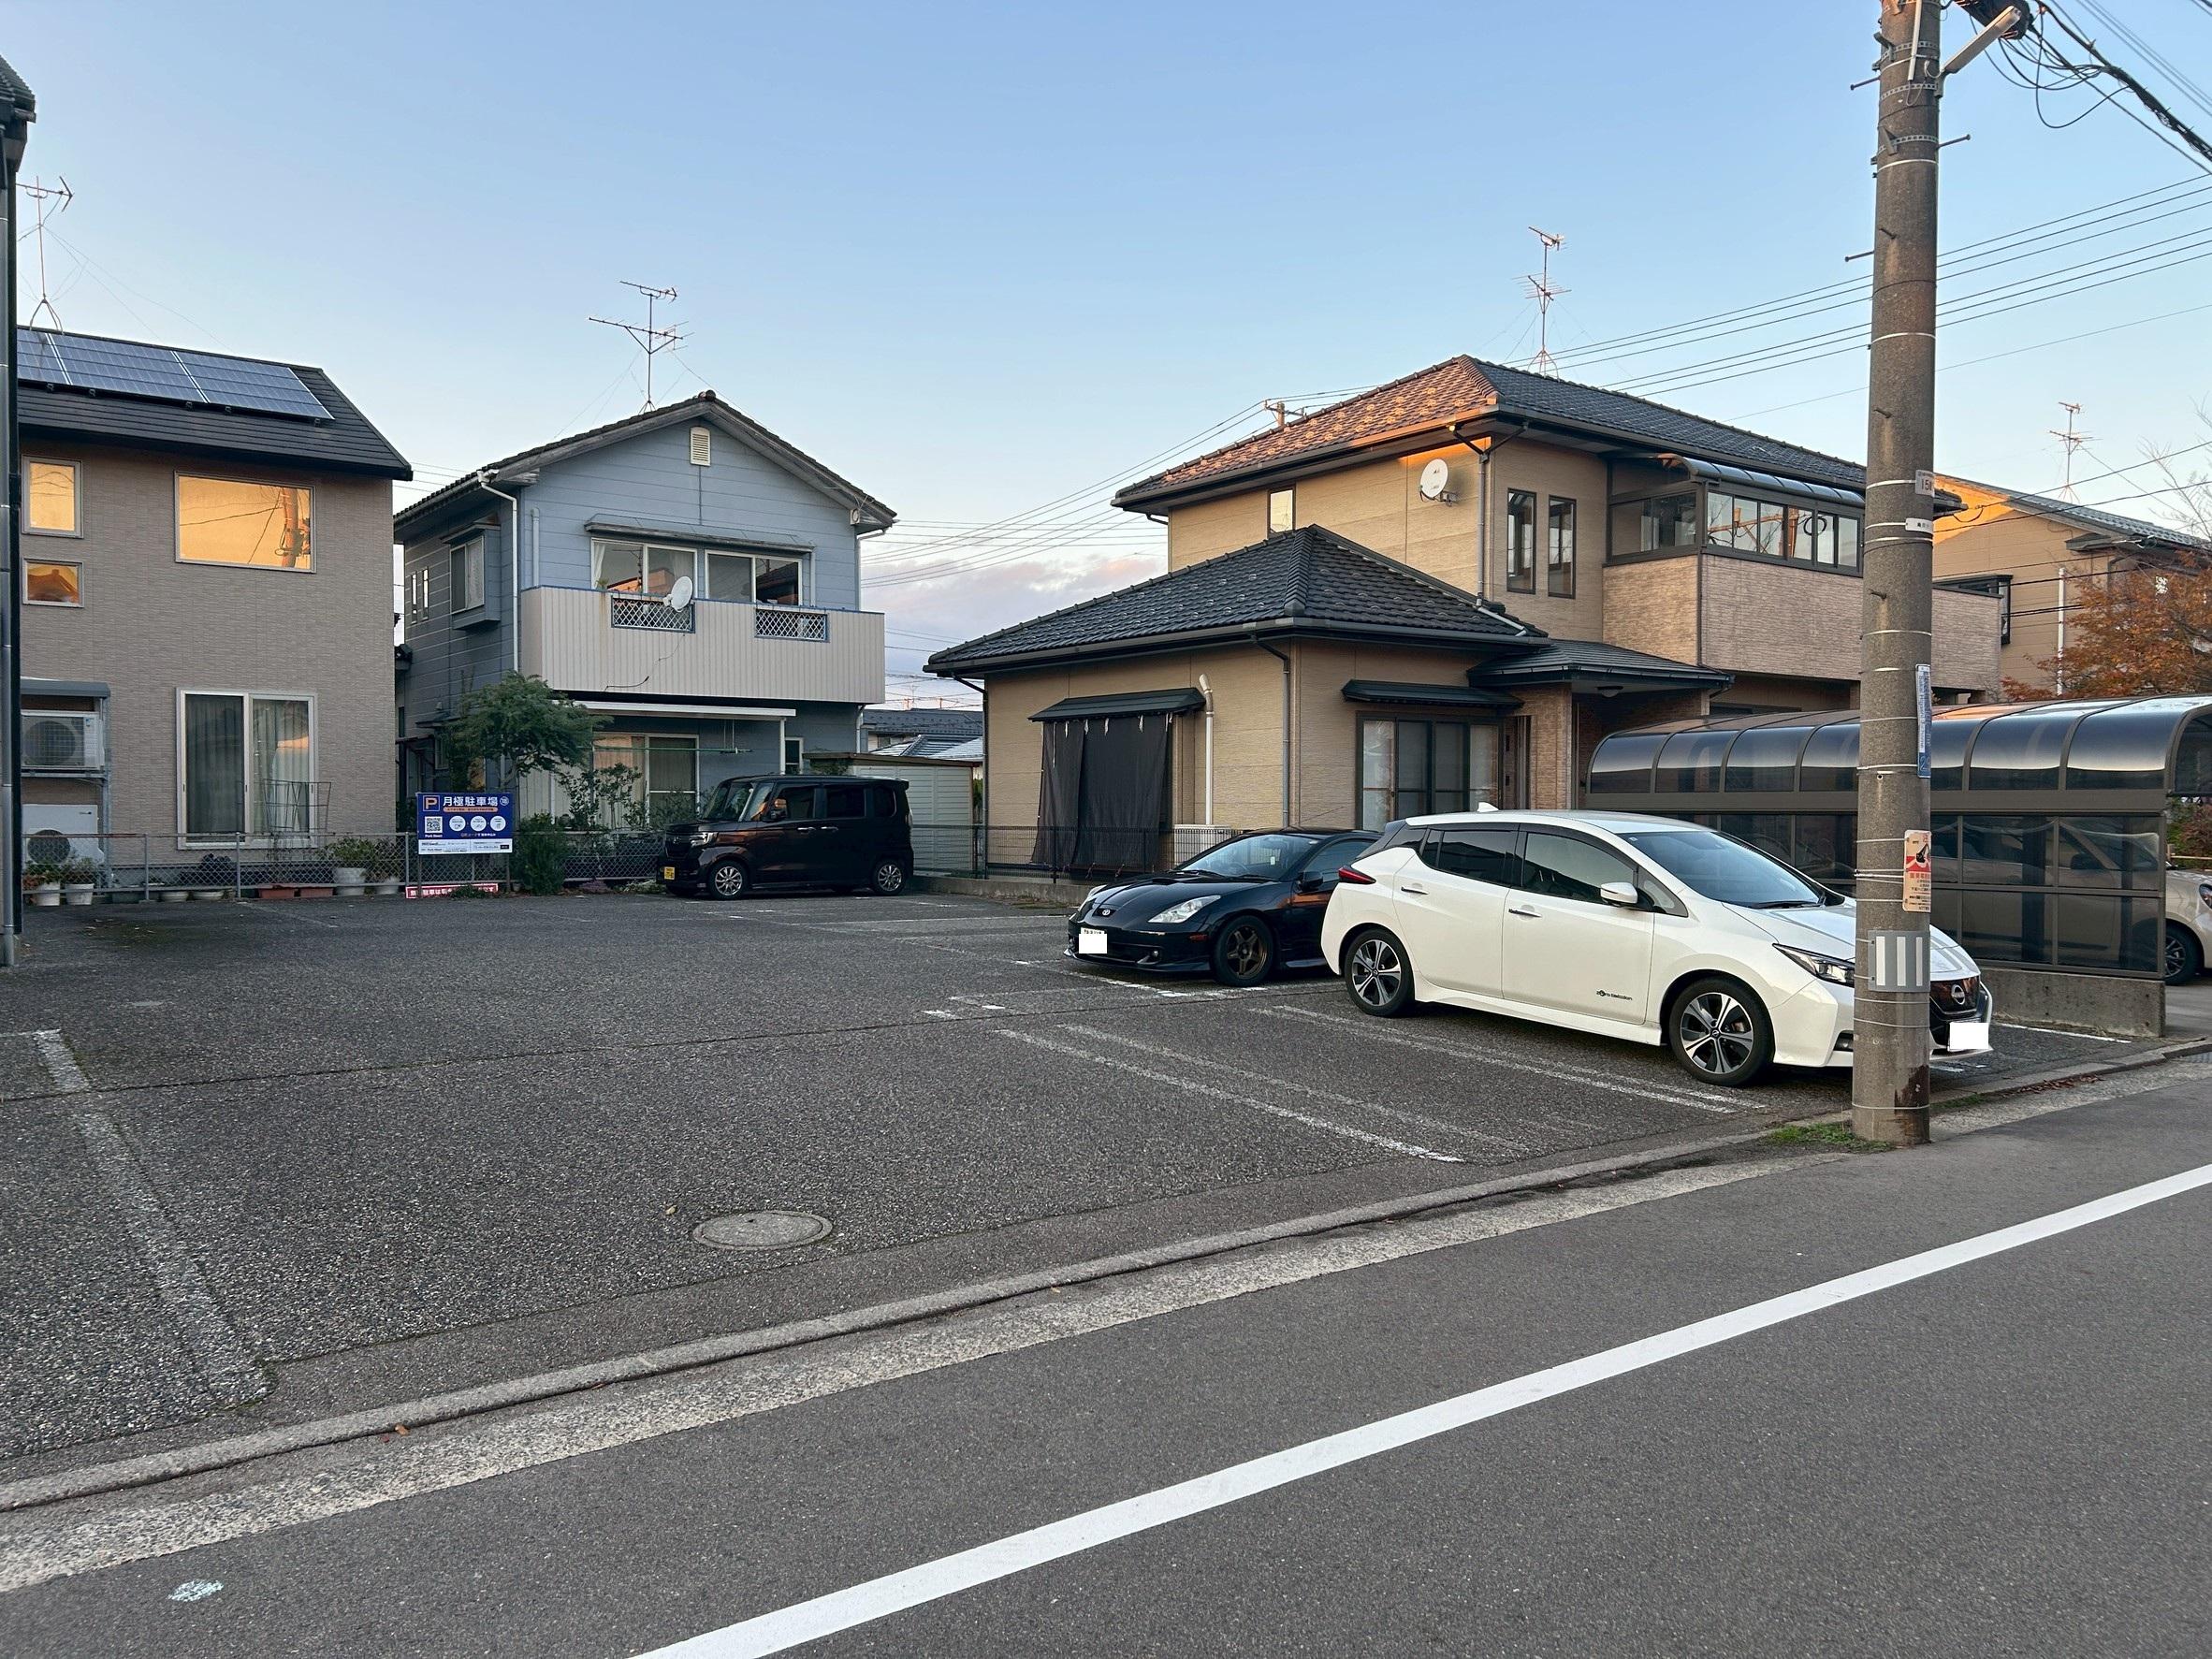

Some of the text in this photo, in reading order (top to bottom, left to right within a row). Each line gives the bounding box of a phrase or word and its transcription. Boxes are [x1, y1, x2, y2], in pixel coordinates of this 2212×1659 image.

[425, 797, 438, 809] P
[443, 796, 498, 807] 月極駐車場
